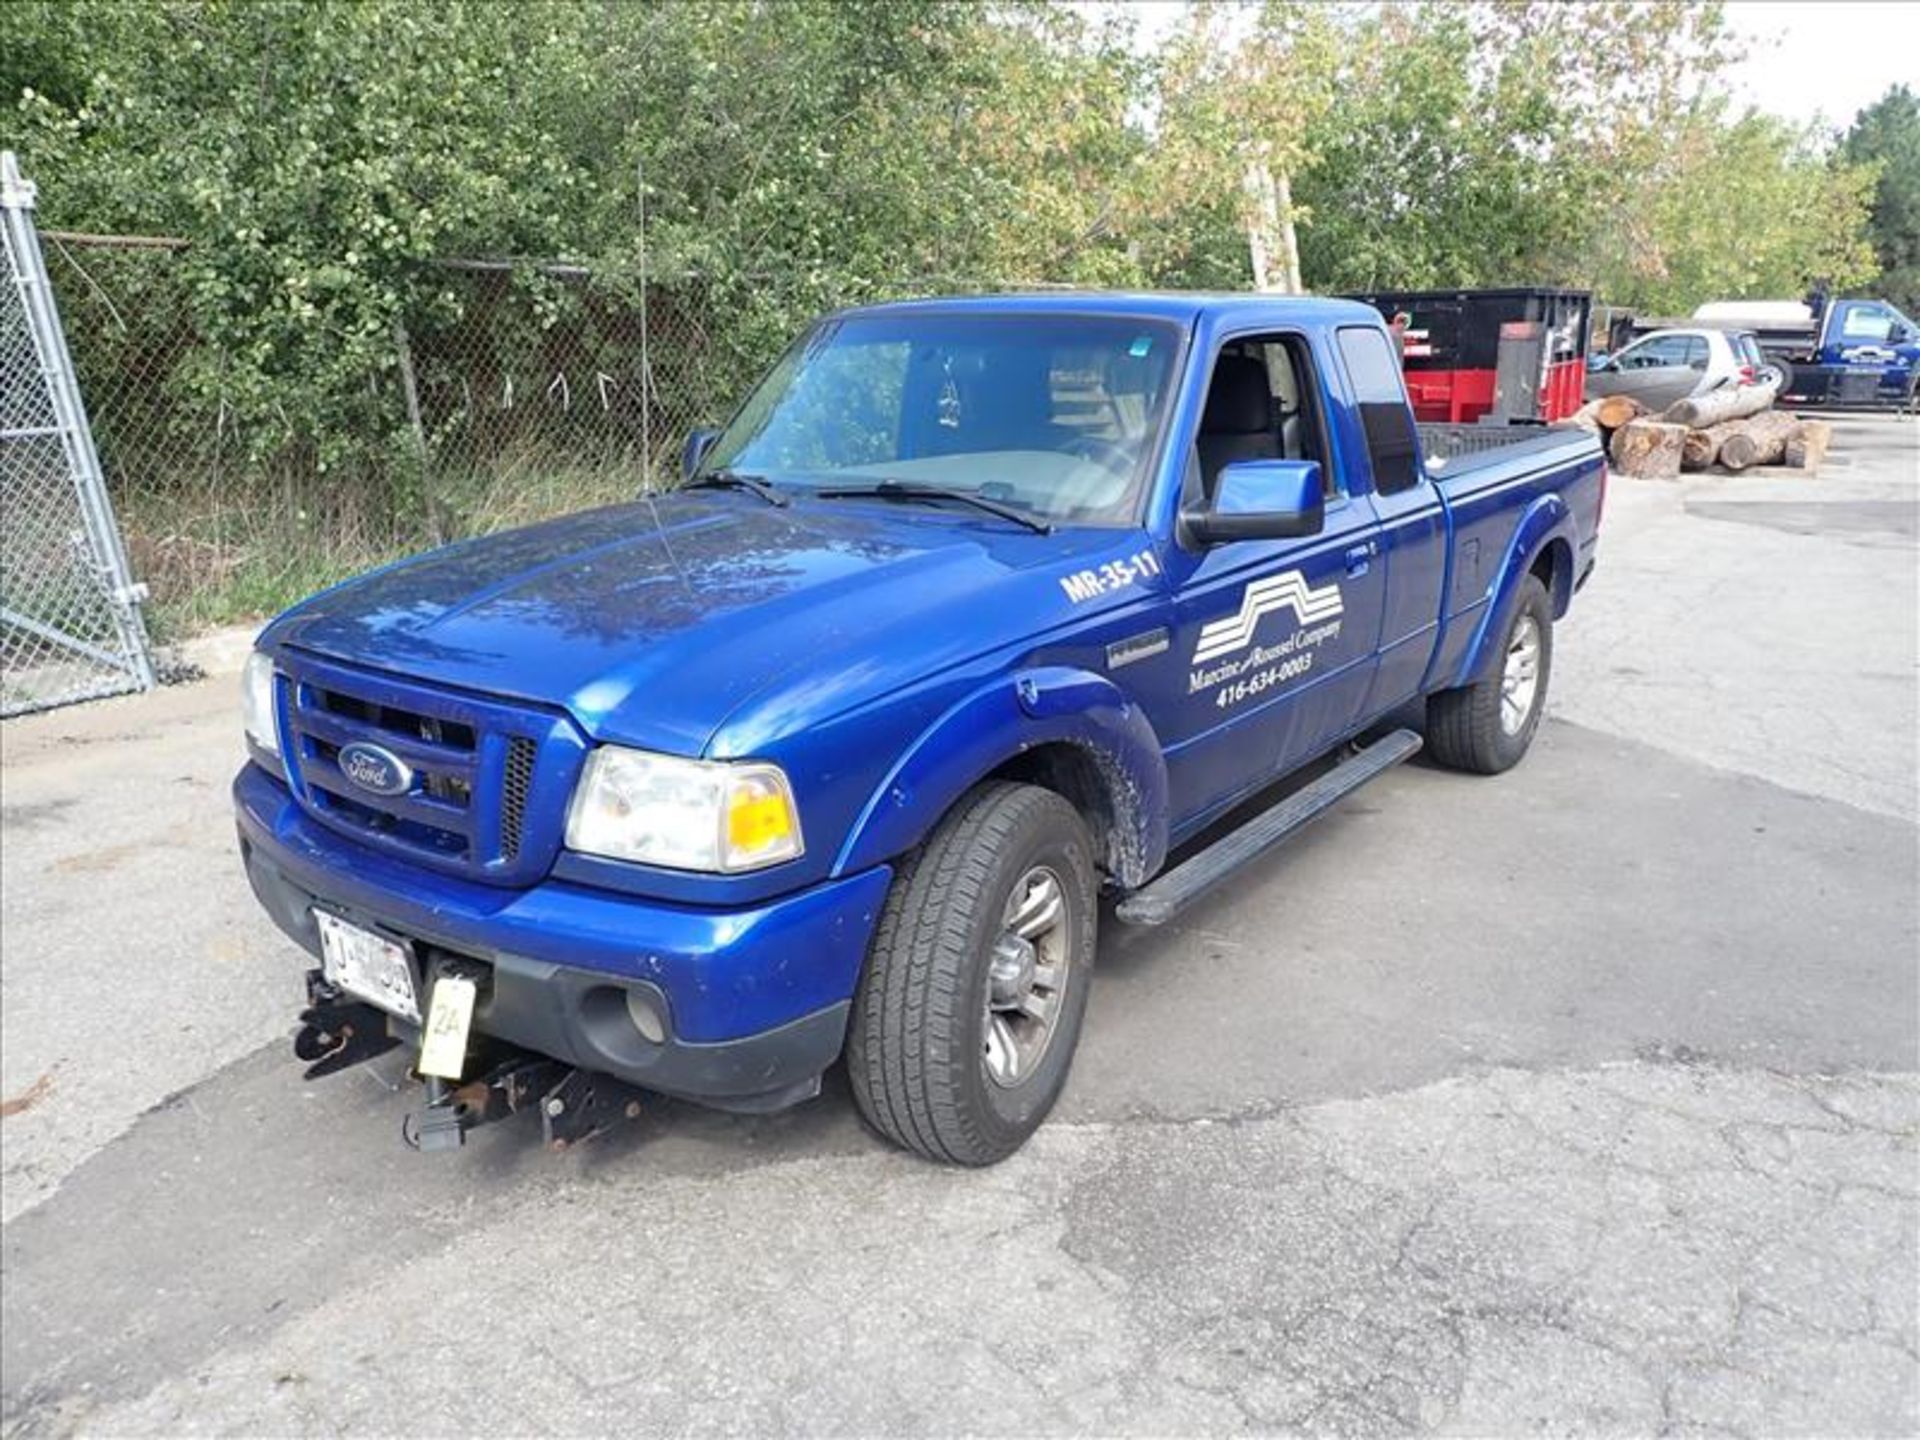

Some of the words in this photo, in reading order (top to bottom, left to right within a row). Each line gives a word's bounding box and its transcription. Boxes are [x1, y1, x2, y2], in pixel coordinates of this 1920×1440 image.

[1060, 550, 1159, 604] MR-35-11
[1295, 620, 1342, 648] Company
[1216, 652, 1313, 708] 416-634-0003
[349, 750, 388, 786] Ford
